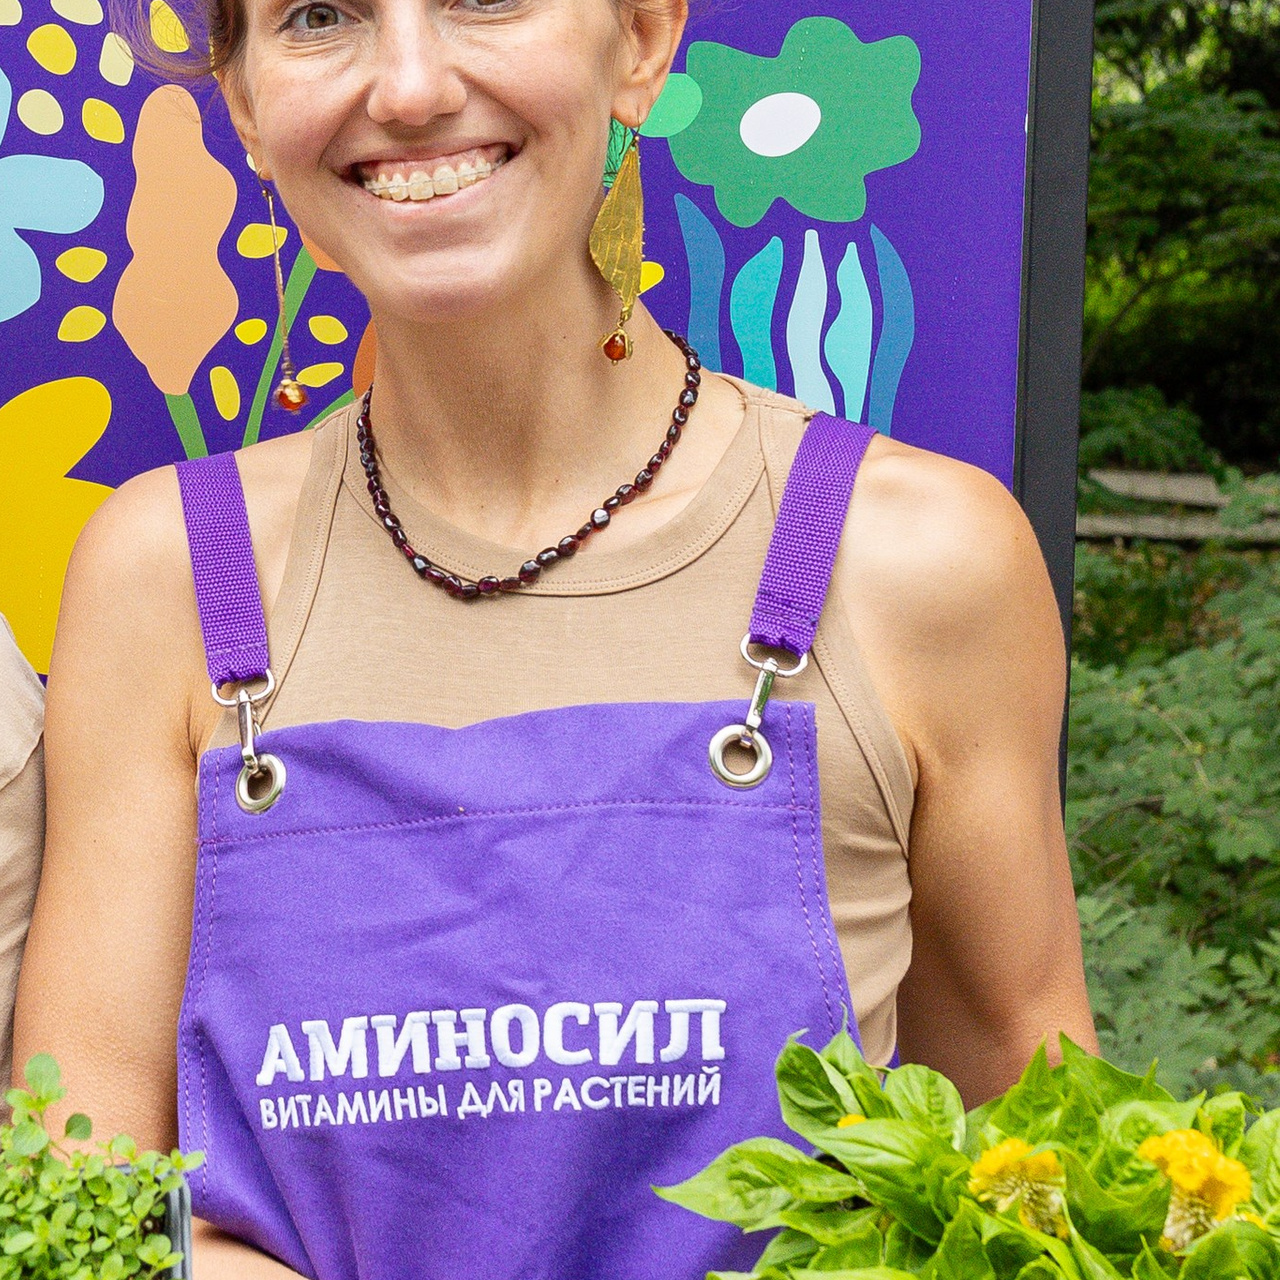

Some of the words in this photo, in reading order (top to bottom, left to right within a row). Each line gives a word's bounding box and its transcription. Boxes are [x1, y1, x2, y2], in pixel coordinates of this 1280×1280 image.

[255, 999, 727, 1087] АМИНОСИЛ
[259, 1084, 447, 1131] ВИТАМИНЫ
[456, 1080, 526, 1118] ДЛЯ
[533, 1066, 721, 1113] РАСТЕНИЙ
